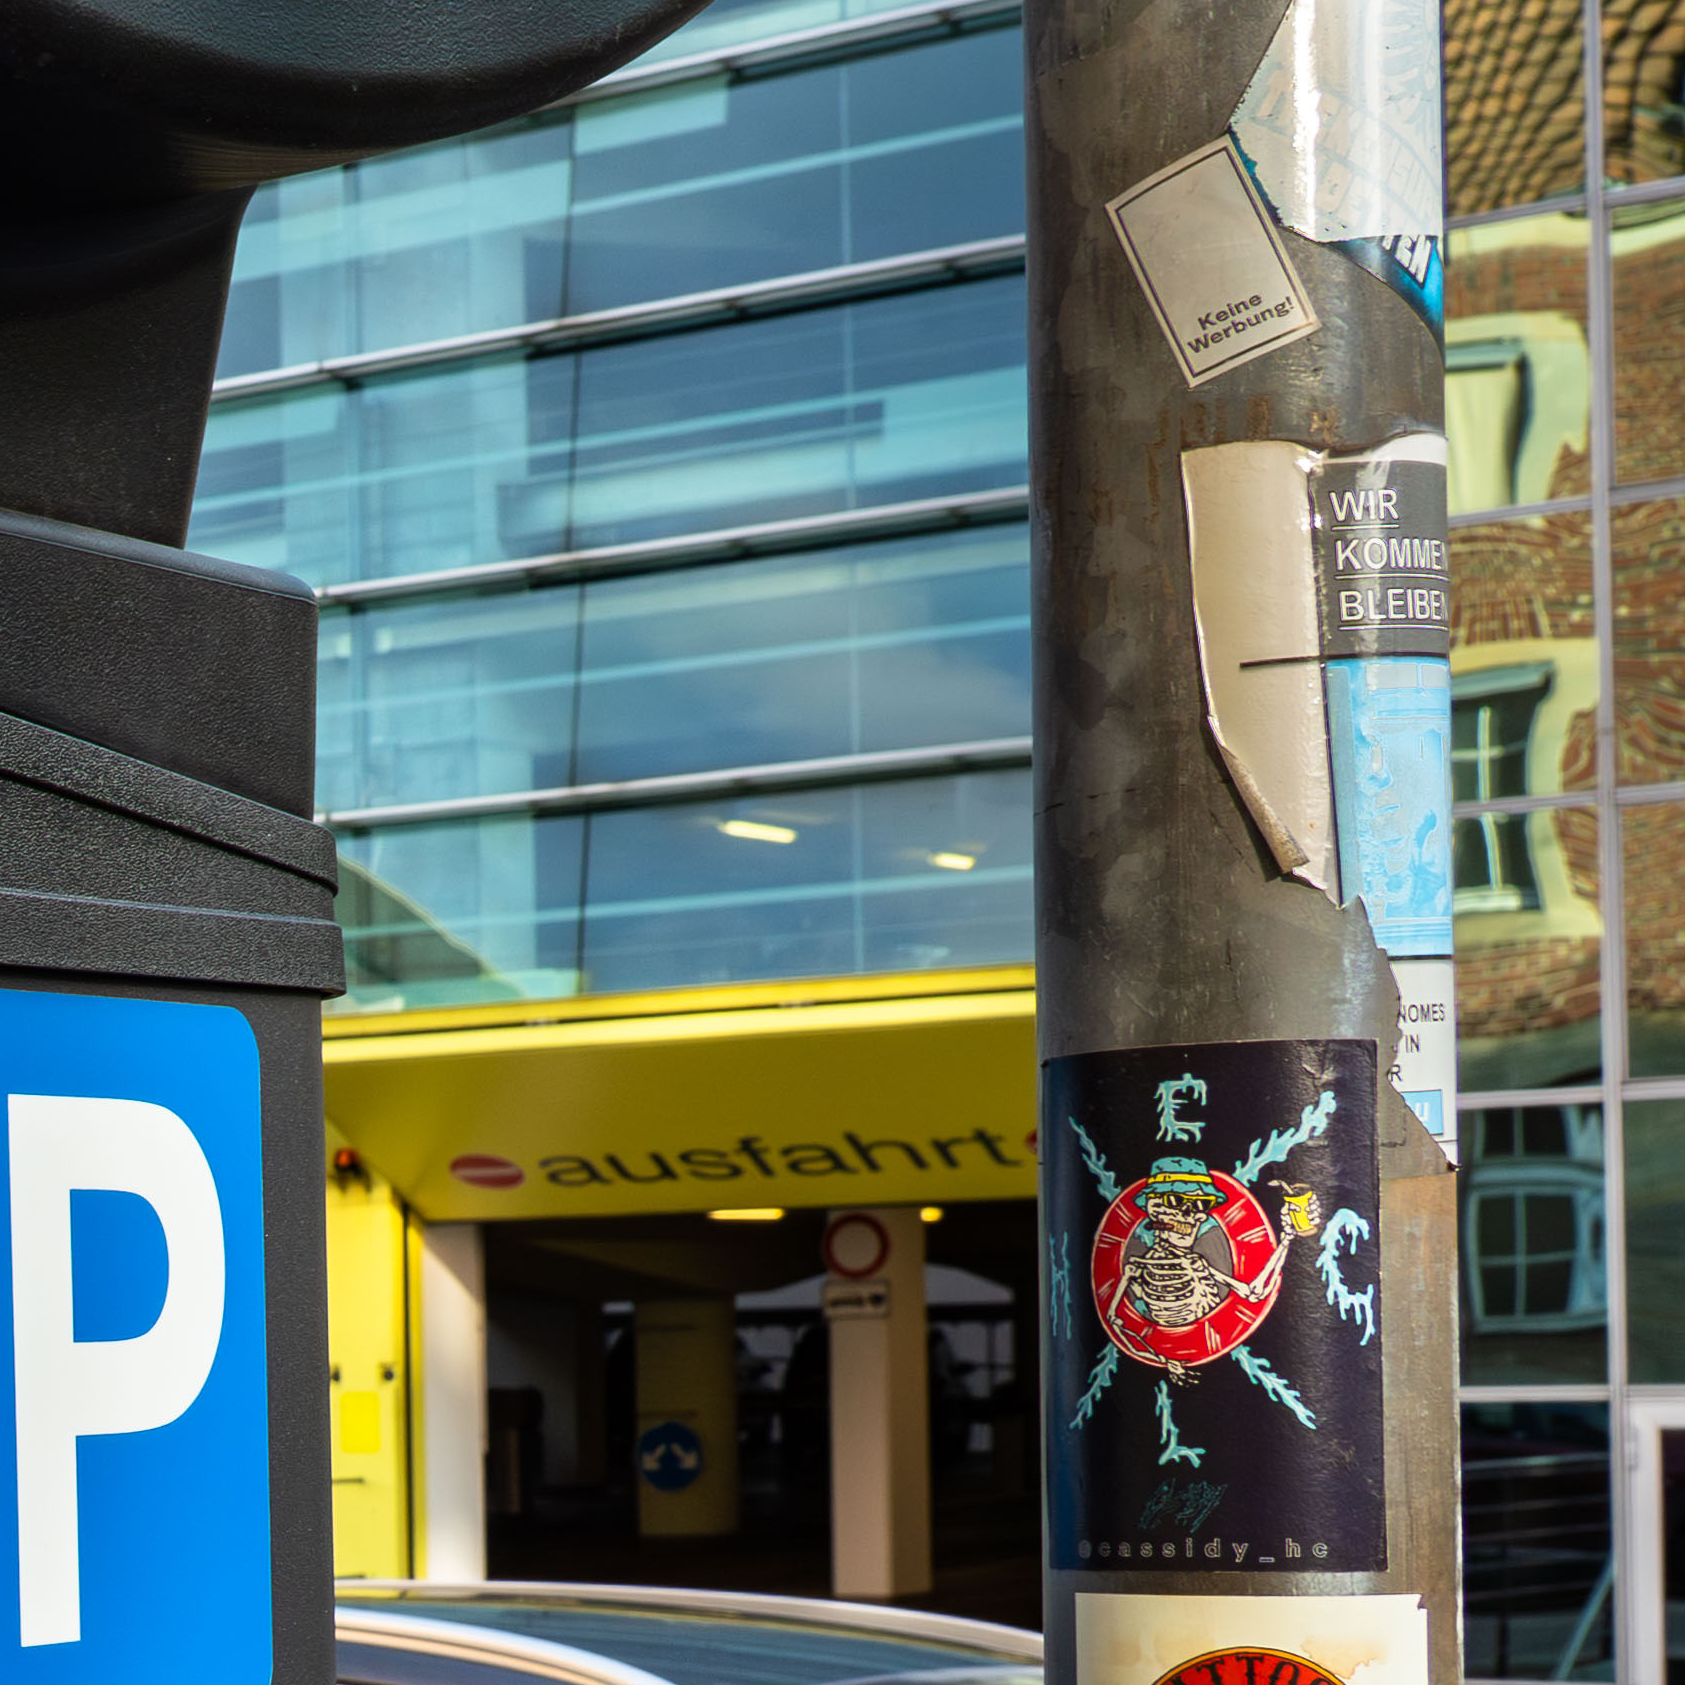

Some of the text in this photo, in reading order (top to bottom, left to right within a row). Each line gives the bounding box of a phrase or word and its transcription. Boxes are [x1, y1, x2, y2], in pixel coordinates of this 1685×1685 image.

[1187, 296, 1295, 353] Werbung!
[1197, 294, 1262, 331] Keine
[1329, 488, 1400, 522] WIR
[538, 1127, 1024, 1187] ausfahrt
[7, 1092, 225, 1648] P
